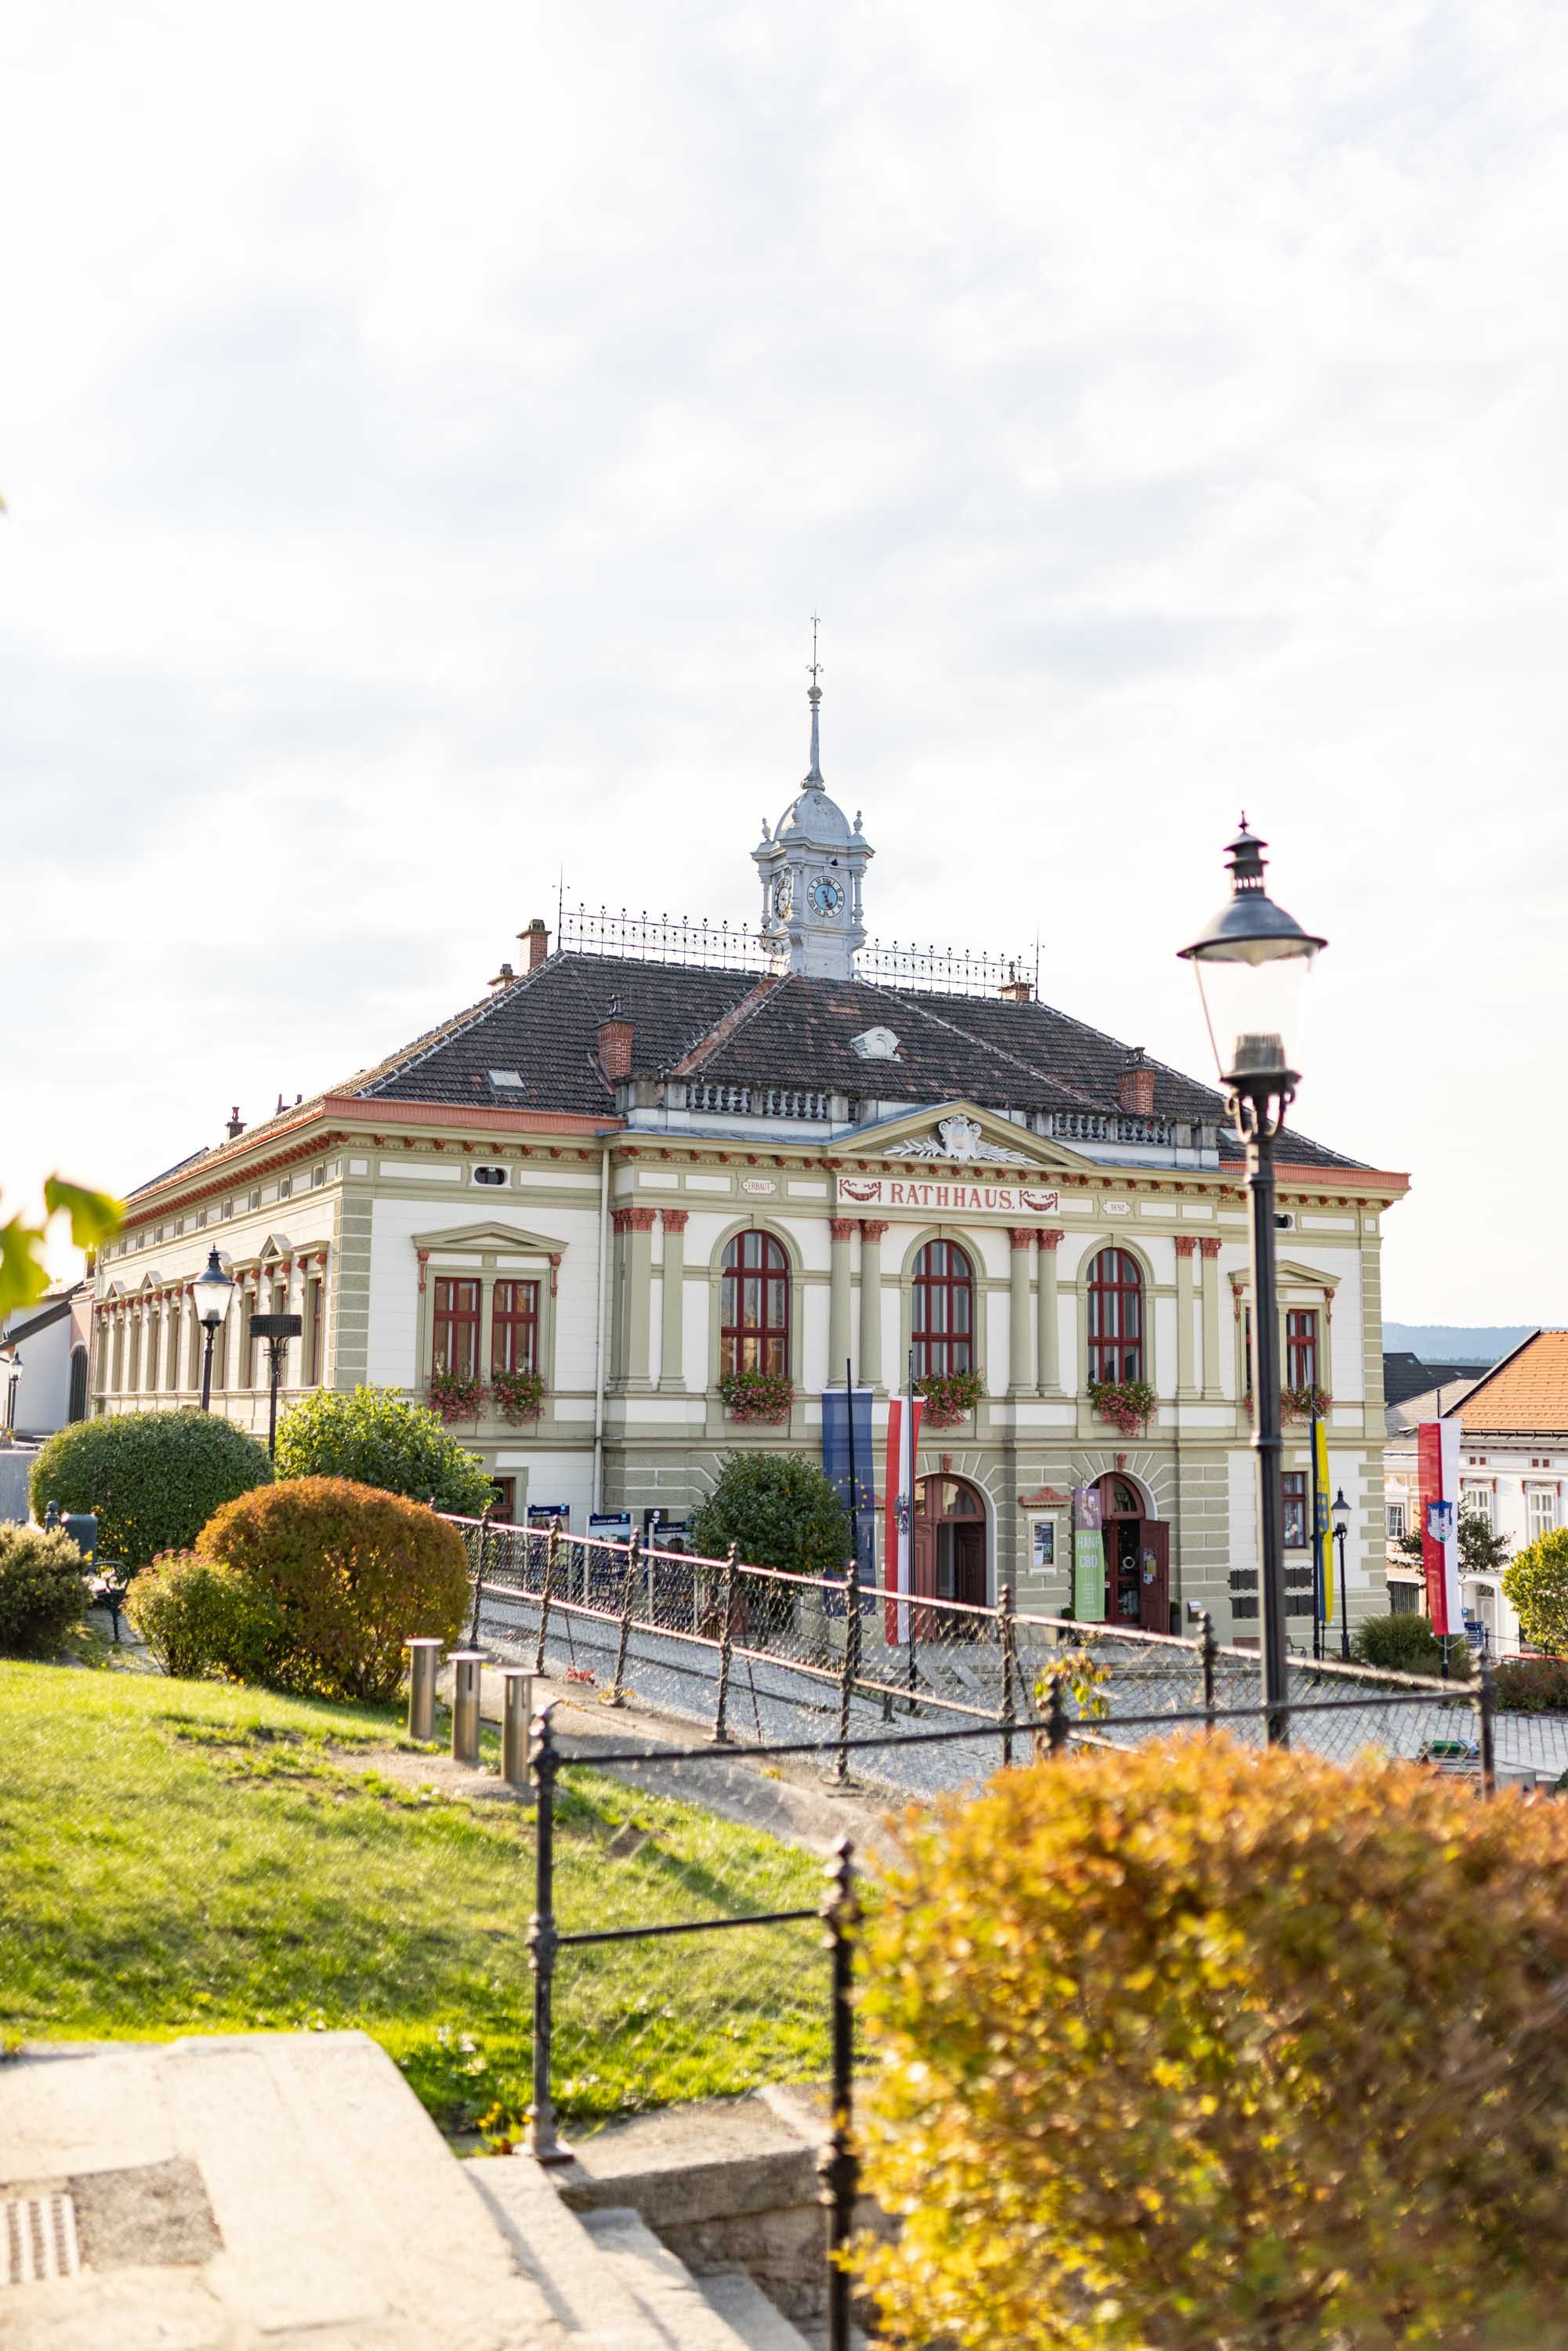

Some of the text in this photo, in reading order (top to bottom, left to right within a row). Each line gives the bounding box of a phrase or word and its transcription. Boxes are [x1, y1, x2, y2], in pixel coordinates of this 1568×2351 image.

[890, 1183, 1016, 1210] RATHHAUS.
[1077, 1536, 1101, 1549] HANF
[1078, 1554, 1098, 1568] CBD
